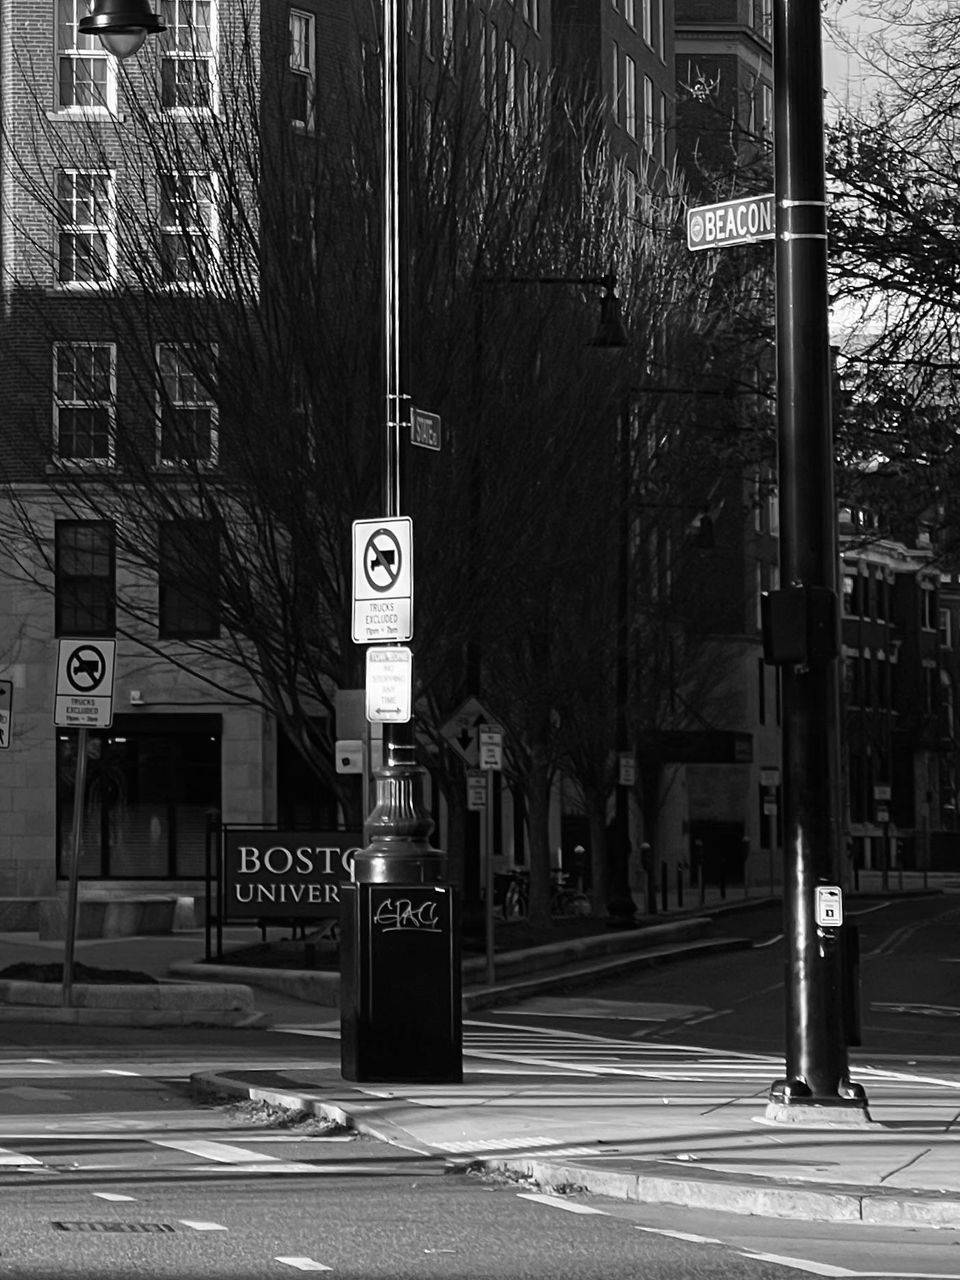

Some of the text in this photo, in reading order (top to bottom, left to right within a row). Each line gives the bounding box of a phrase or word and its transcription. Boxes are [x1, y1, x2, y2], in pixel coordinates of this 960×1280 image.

[705, 201, 771, 241] BEACON
[369, 602, 394, 612] TRUCKS
[365, 614, 398, 624] EXCLUDED
[71, 698, 95, 706] TRUCKS
[66, 706, 99, 714] EXCLUDED
[235, 883, 340, 903] UNIVER
